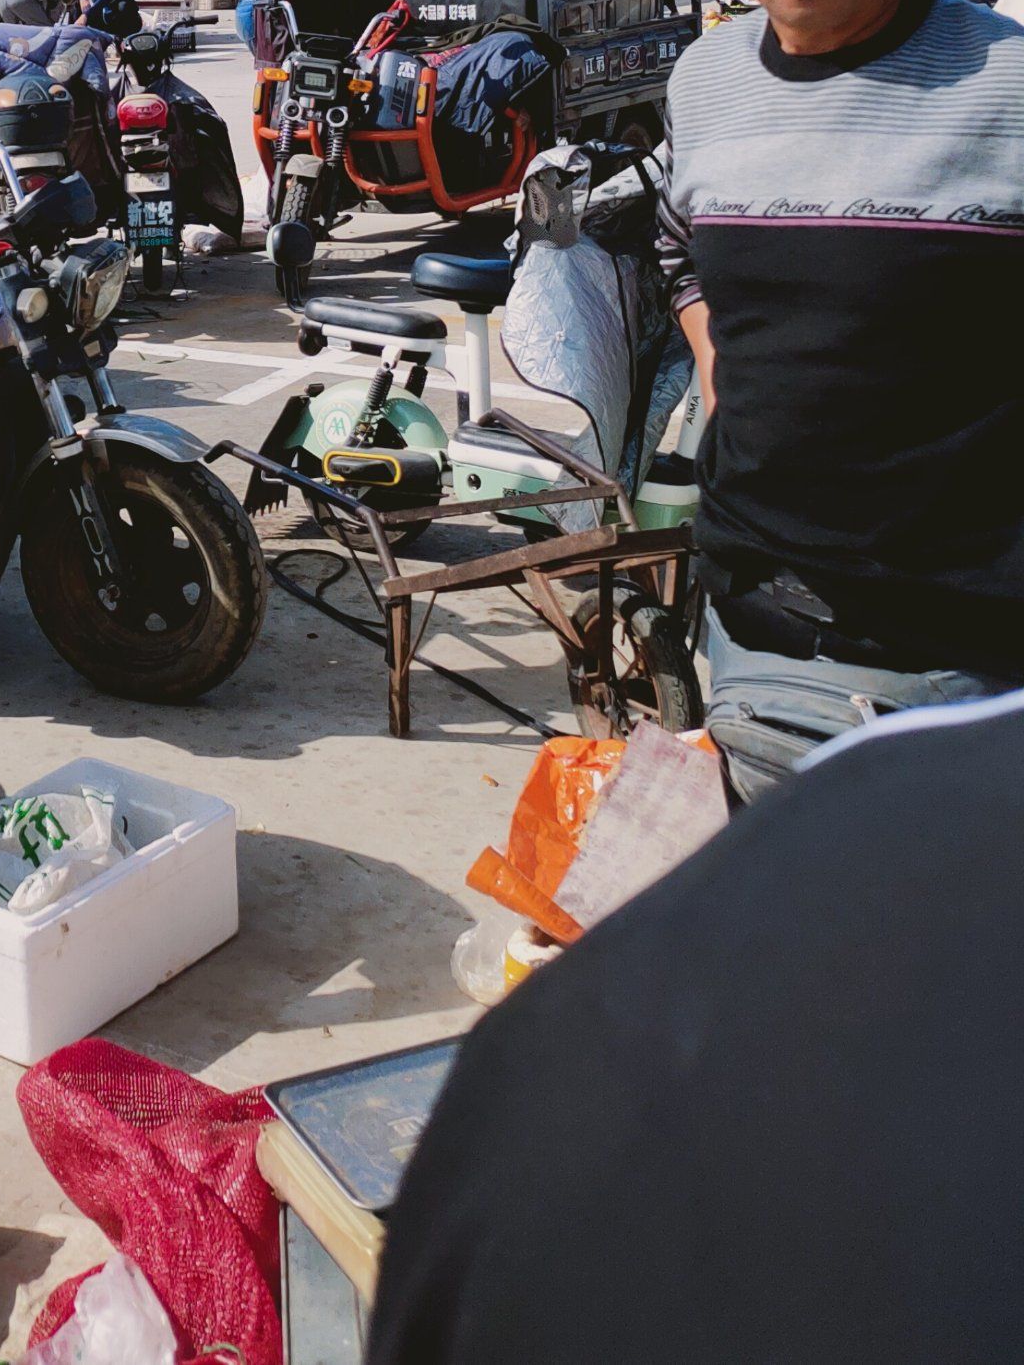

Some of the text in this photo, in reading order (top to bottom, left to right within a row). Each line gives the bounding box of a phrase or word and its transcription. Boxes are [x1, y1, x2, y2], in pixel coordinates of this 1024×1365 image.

[449, 4, 476, 21] 好车辆
[127, 201, 174, 227] 新世纪
[686, 395, 701, 425] AIMA
